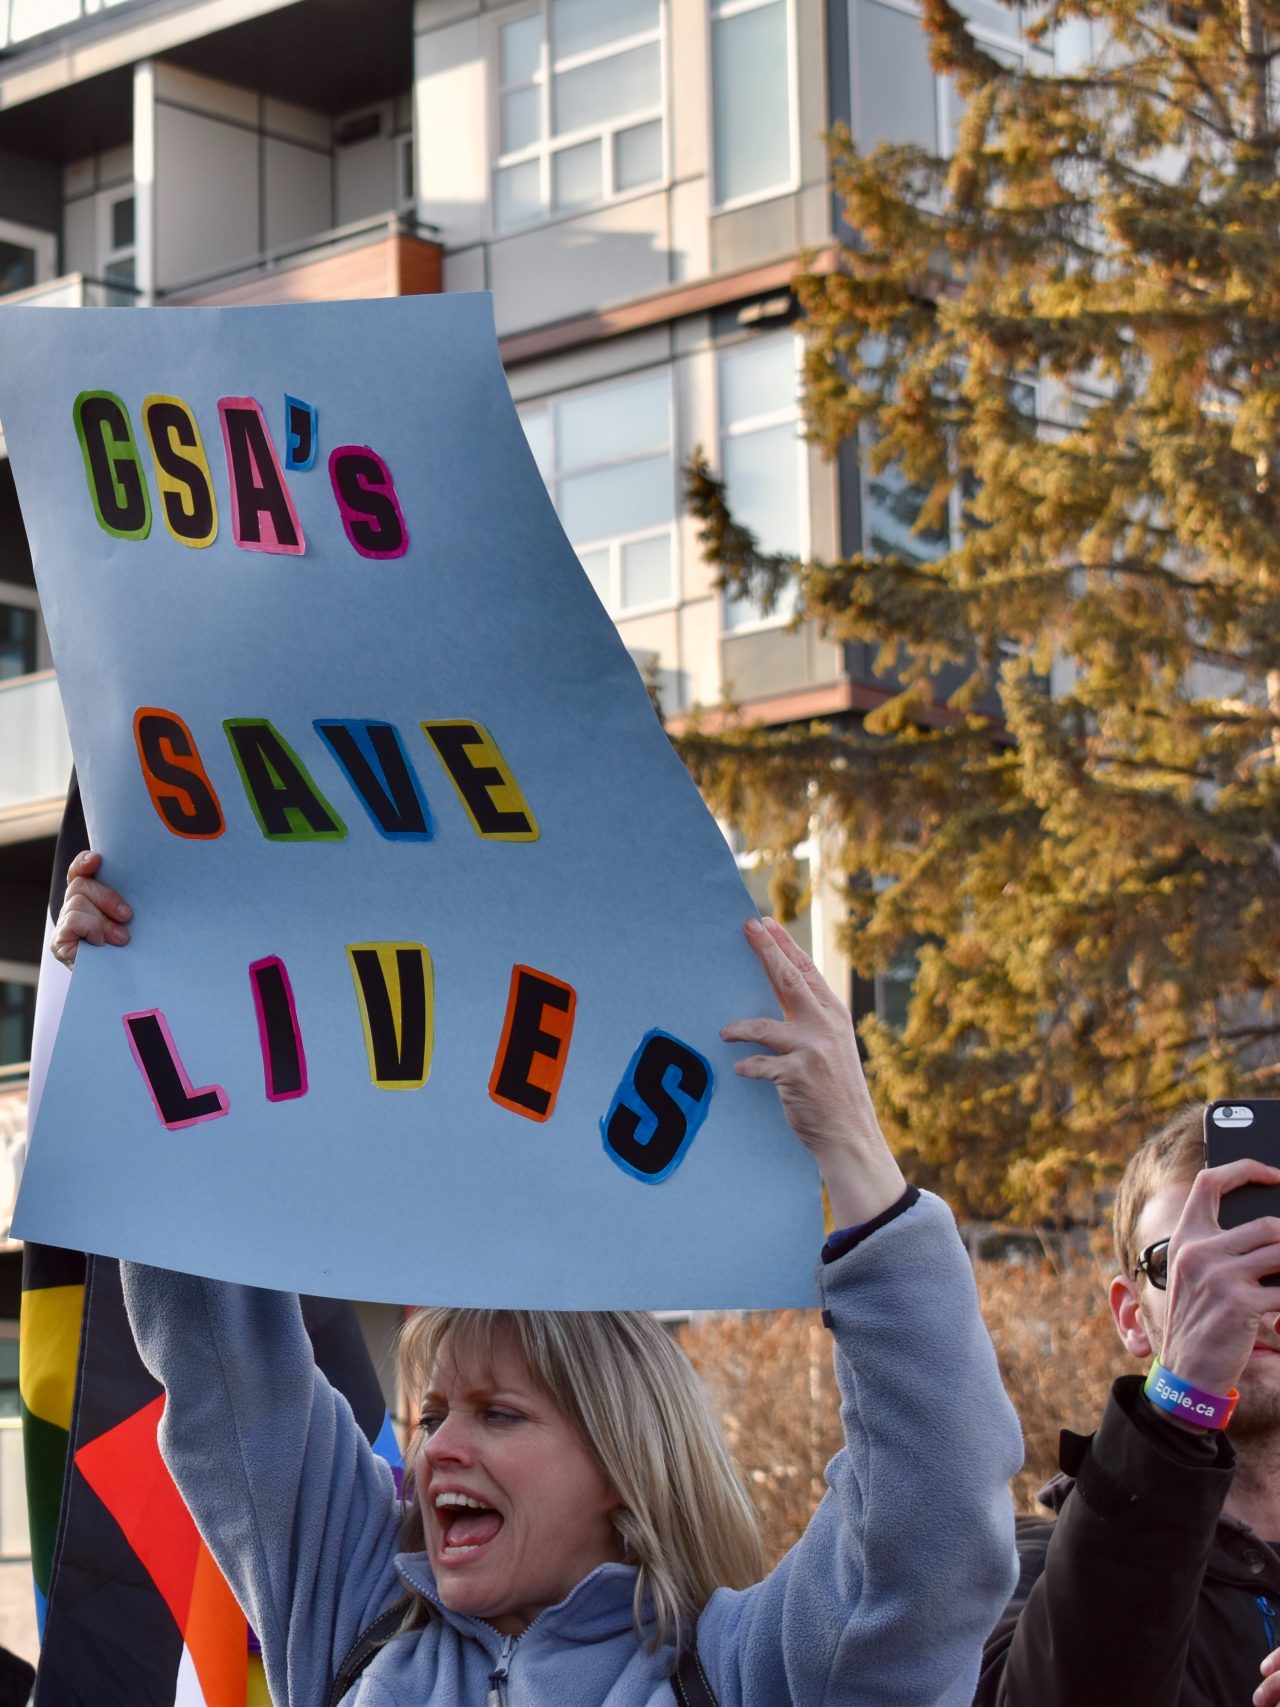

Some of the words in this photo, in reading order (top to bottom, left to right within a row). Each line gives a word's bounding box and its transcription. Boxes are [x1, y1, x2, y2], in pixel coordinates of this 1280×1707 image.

[78, 395, 404, 553] GSA's
[137, 714, 534, 837] SAVE
[125, 947, 710, 1175] LIVES
[1155, 1378, 1215, 1417] Egale.ca
